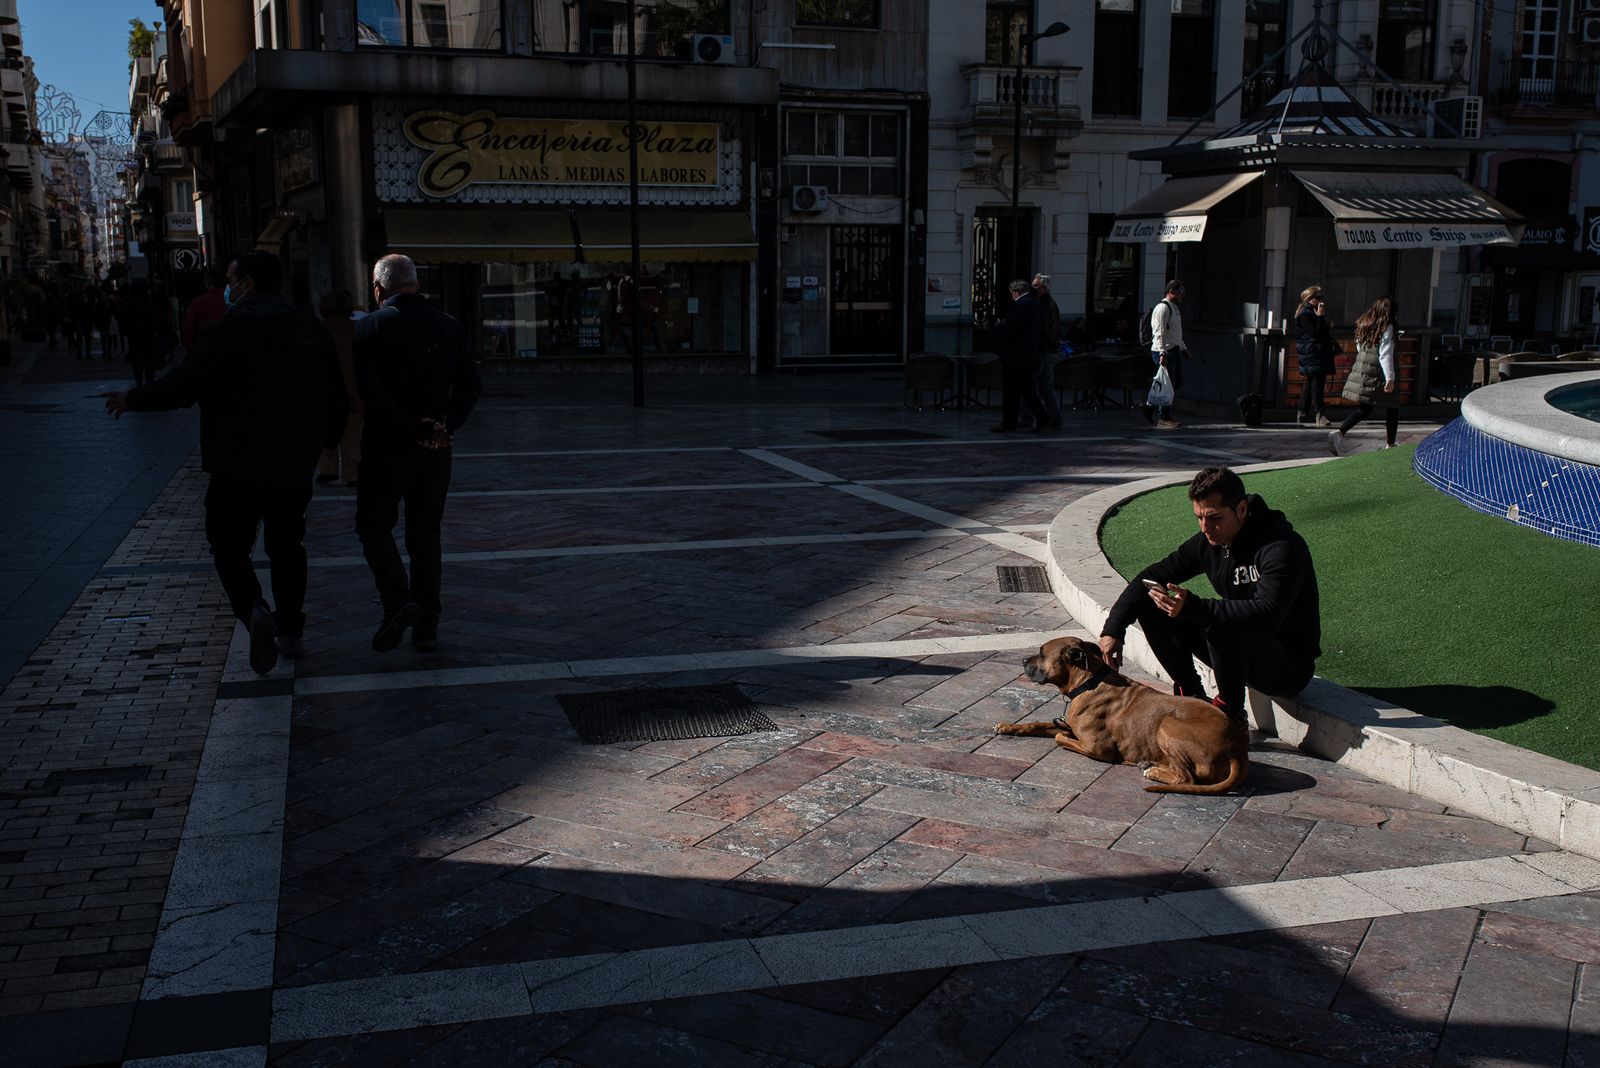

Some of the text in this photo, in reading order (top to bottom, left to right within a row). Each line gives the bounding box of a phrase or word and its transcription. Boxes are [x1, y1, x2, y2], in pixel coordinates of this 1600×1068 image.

[617, 124, 717, 154] Plaza
[499, 165, 707, 184] LANAS MEDIAS LABORES
[1344, 230, 1376, 244] TOLDOS
[1382, 227, 1422, 243] Centro
[1429, 227, 1466, 244] Suizo
